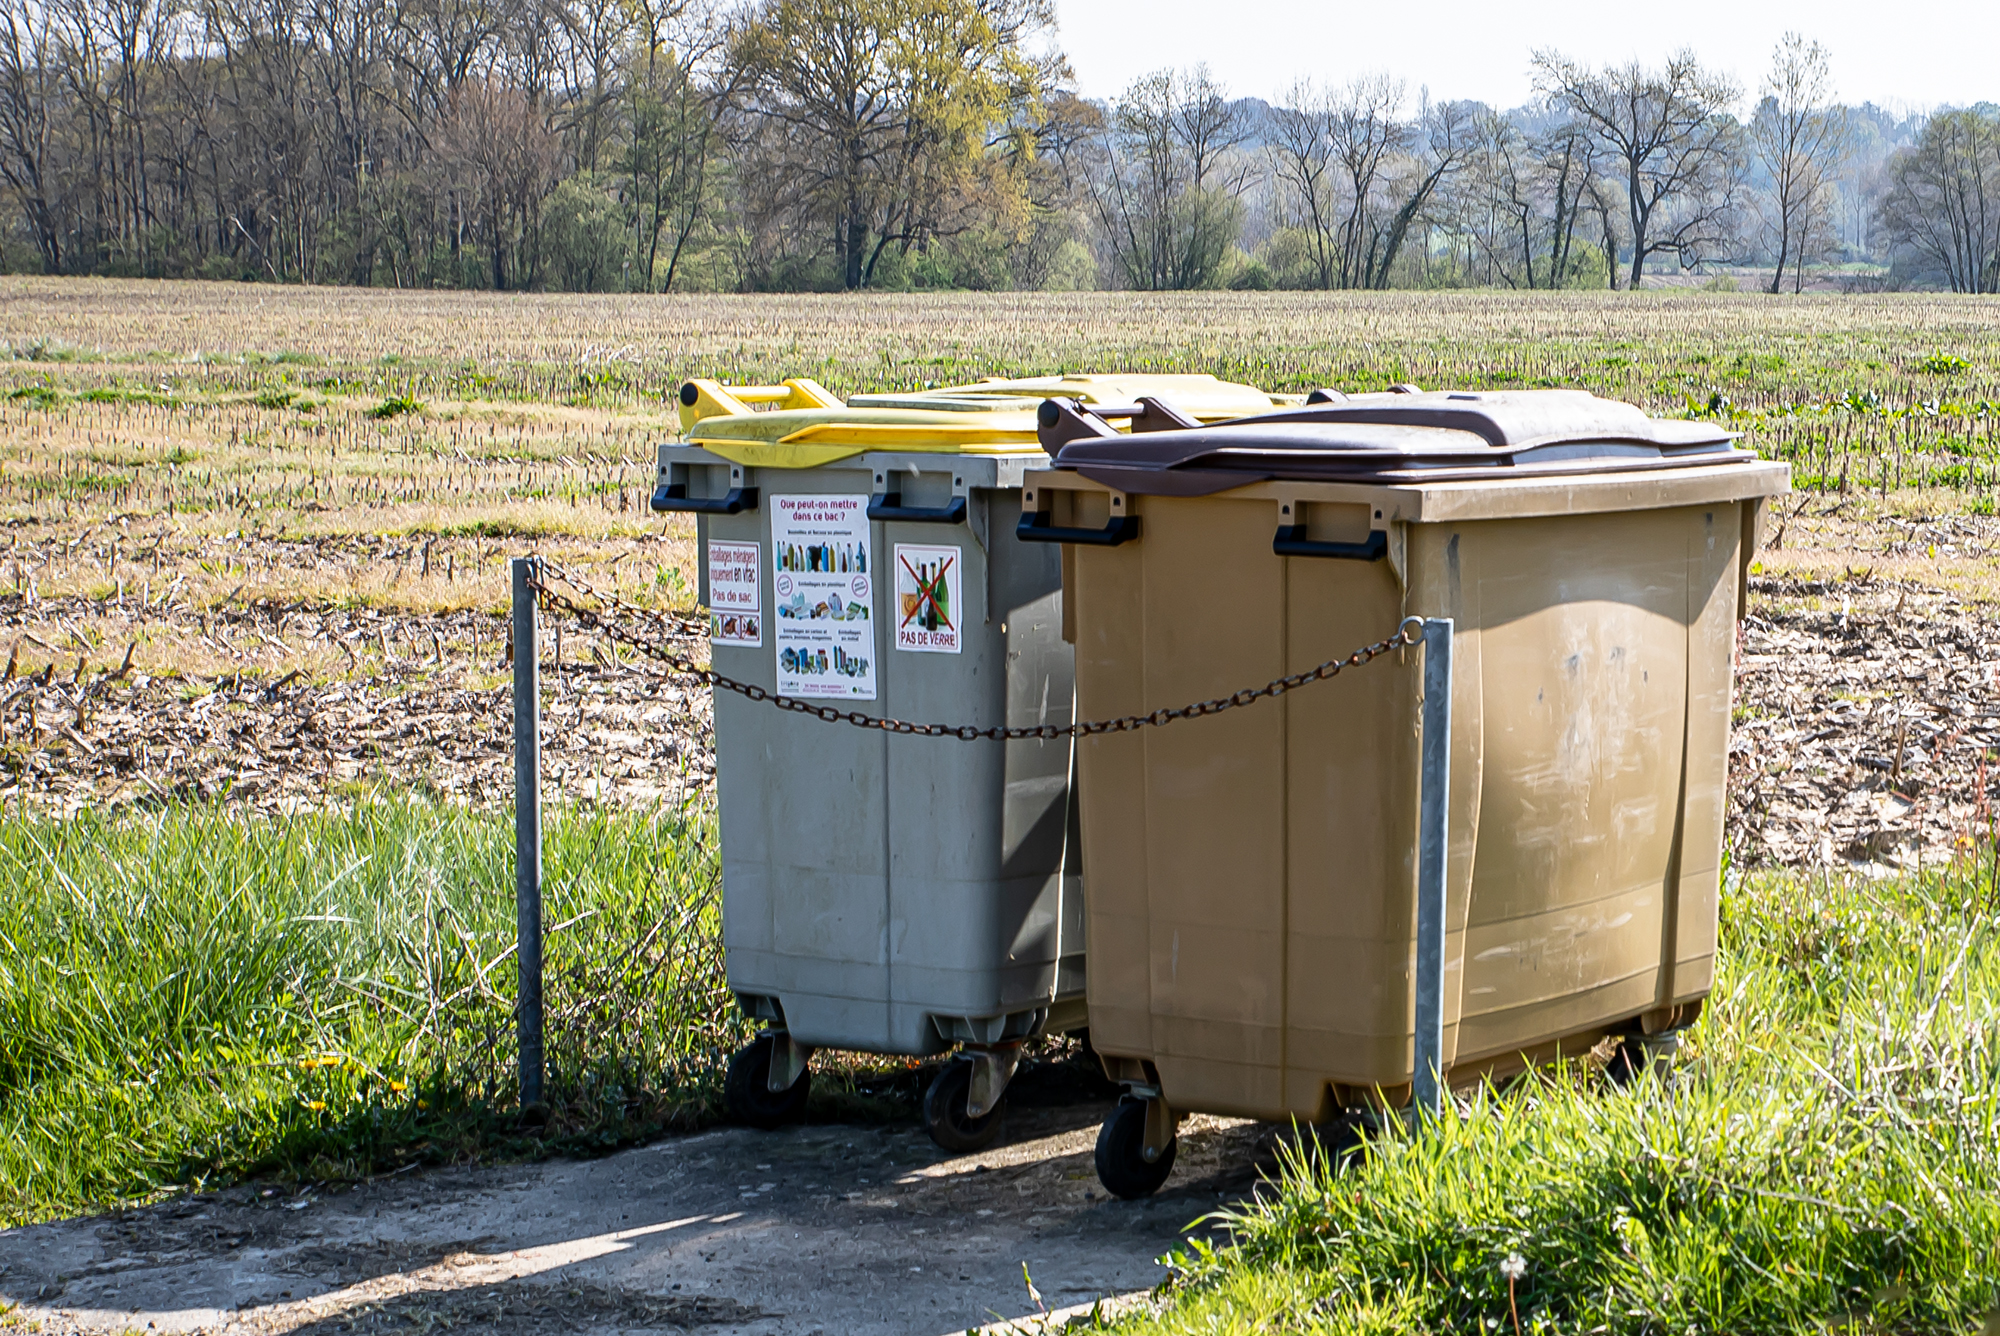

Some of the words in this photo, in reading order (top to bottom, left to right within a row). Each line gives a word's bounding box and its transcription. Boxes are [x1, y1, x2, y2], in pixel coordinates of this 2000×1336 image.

[780, 499, 795, 510] Que
[798, 500, 828, 510] peut-on
[830, 500, 858, 509] mettre
[793, 512, 811, 521] dans
[814, 513, 822, 521] ce
[825, 512, 838, 521] bac
[841, 512, 845, 521] ?
[734, 568, 741, 582] en
[742, 568, 756, 583] vrac
[713, 588, 726, 602] Pas
[727, 590, 736, 602] de
[739, 592, 752, 603] sac
[901, 631, 916, 644] PAS
[918, 632, 928, 645] DE
[930, 632, 955, 646] VERRE
